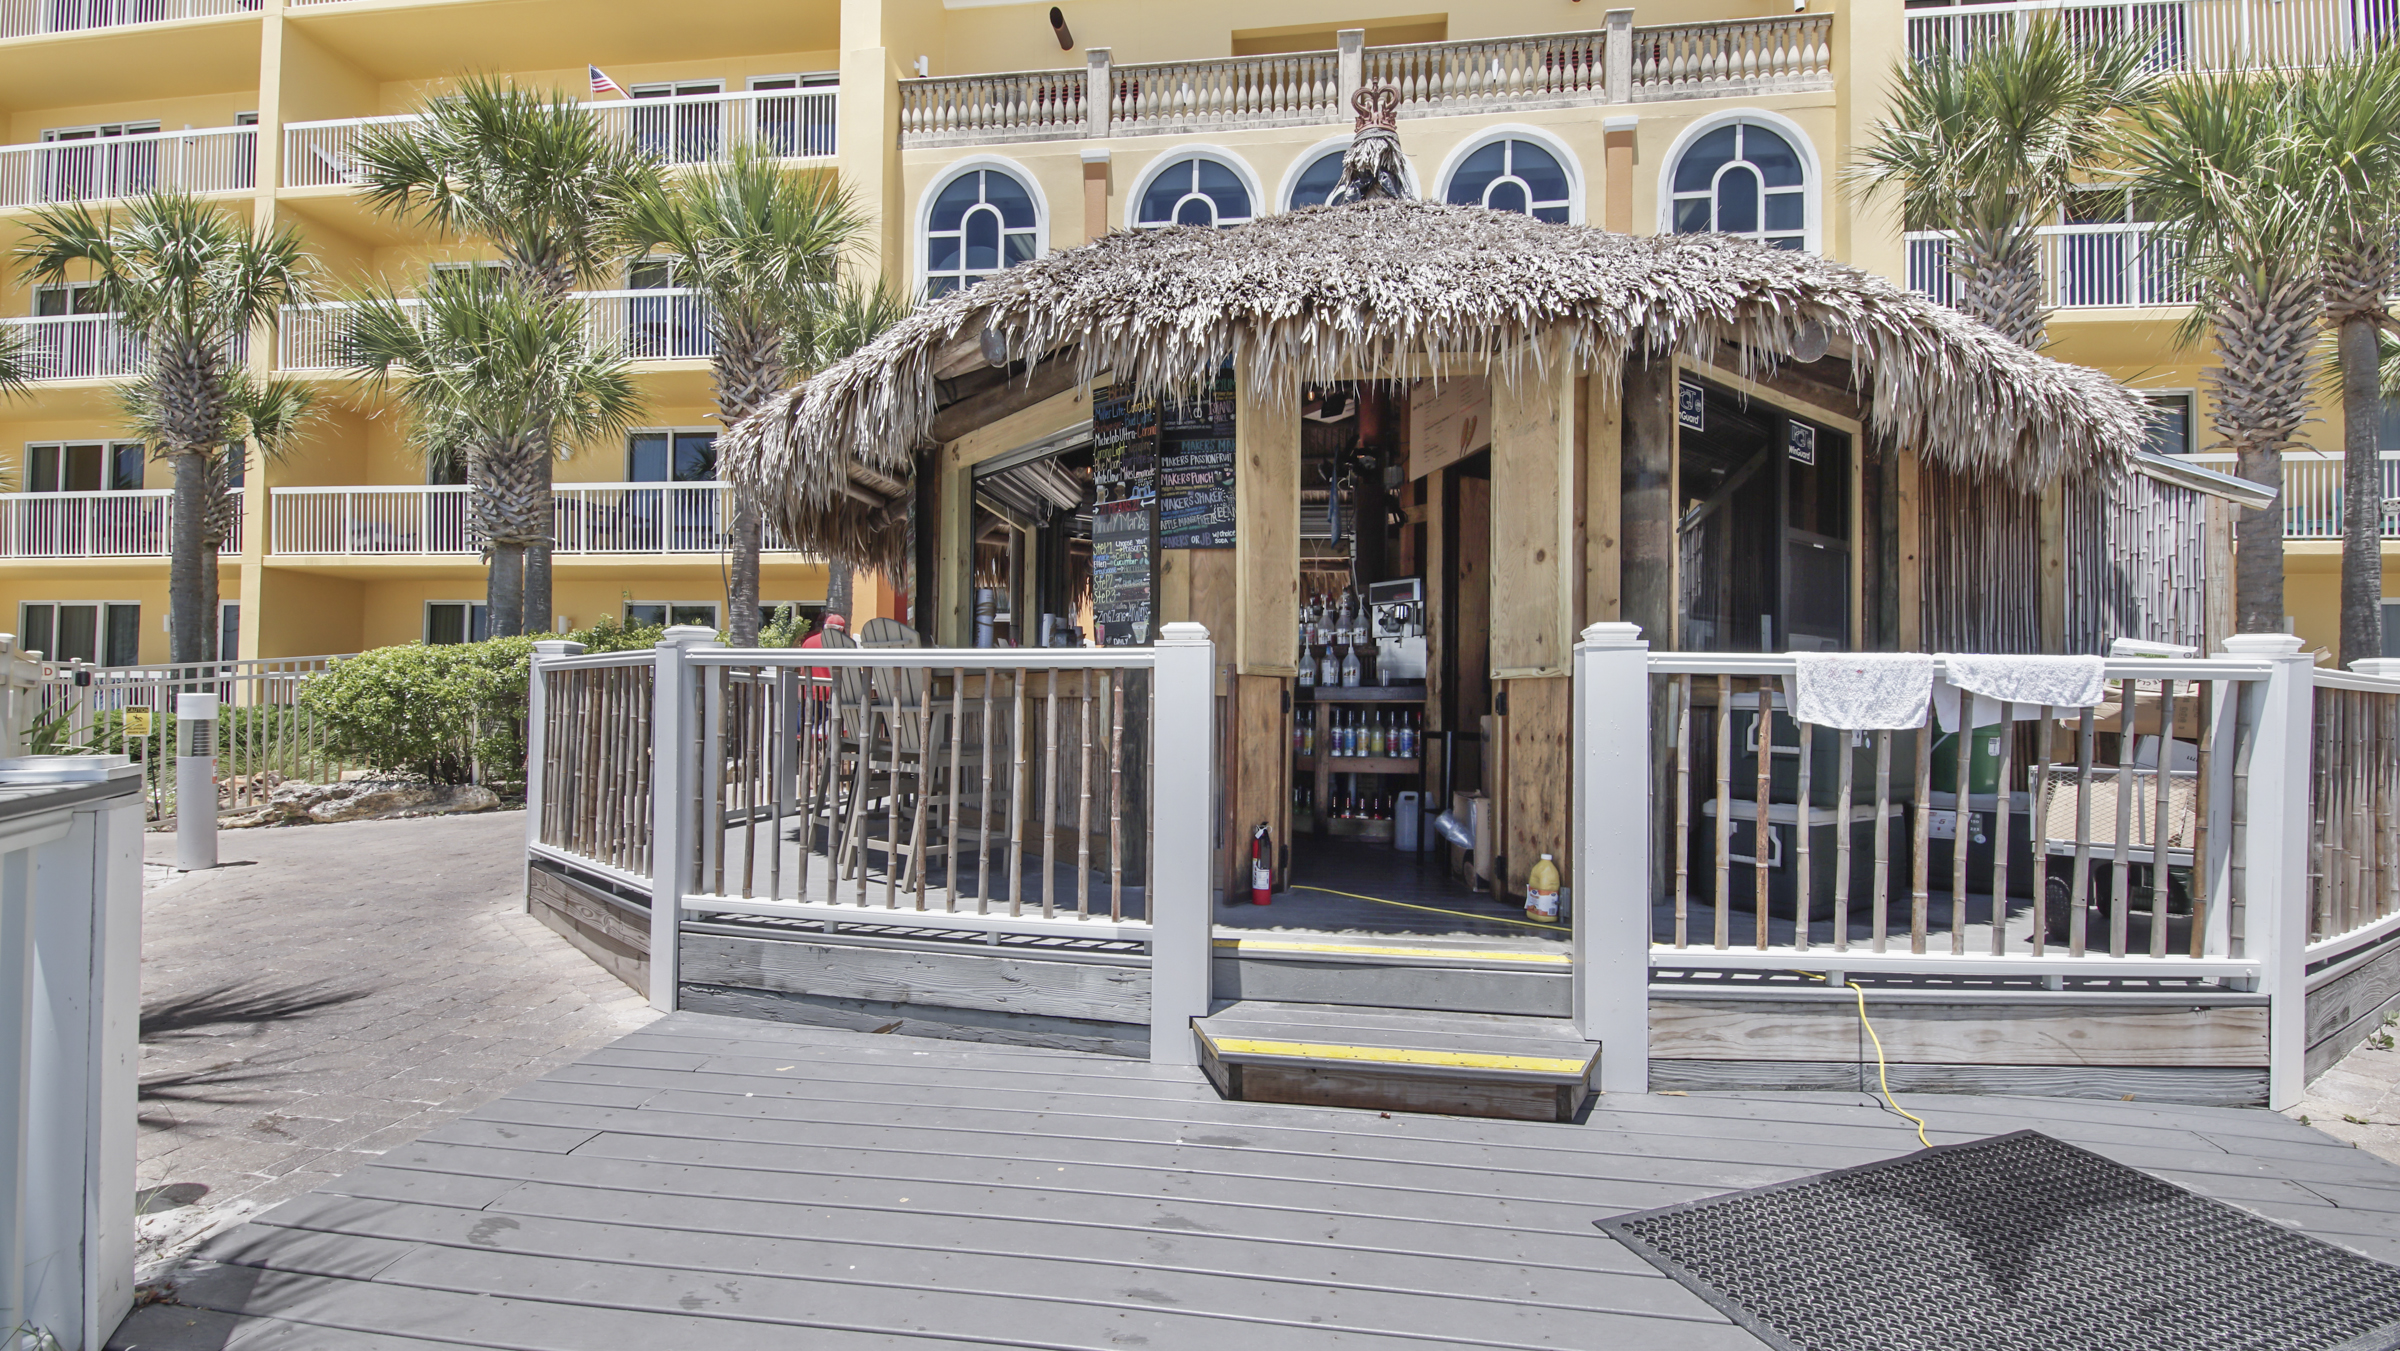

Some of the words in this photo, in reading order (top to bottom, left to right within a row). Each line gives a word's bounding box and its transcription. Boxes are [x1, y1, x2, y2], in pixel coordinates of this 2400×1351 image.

[1108, 381, 1132, 401] BEER
[1112, 403, 1124, 418] Lite
[1094, 428, 1119, 448] Michelob
[1161, 454, 1189, 467] MAKERS
[1161, 473, 1190, 486] MAKERS
[1191, 471, 1214, 485] PUNCH
[1160, 495, 1193, 512] MAKERS
[1194, 490, 1224, 505] SHAKER
[1160, 519, 1178, 530] APPLE
[1160, 534, 1190, 549] MAKERS
[1190, 535, 1200, 544] OR
[1200, 532, 1212, 546] JB
[1113, 638, 1128, 646] DAILY
